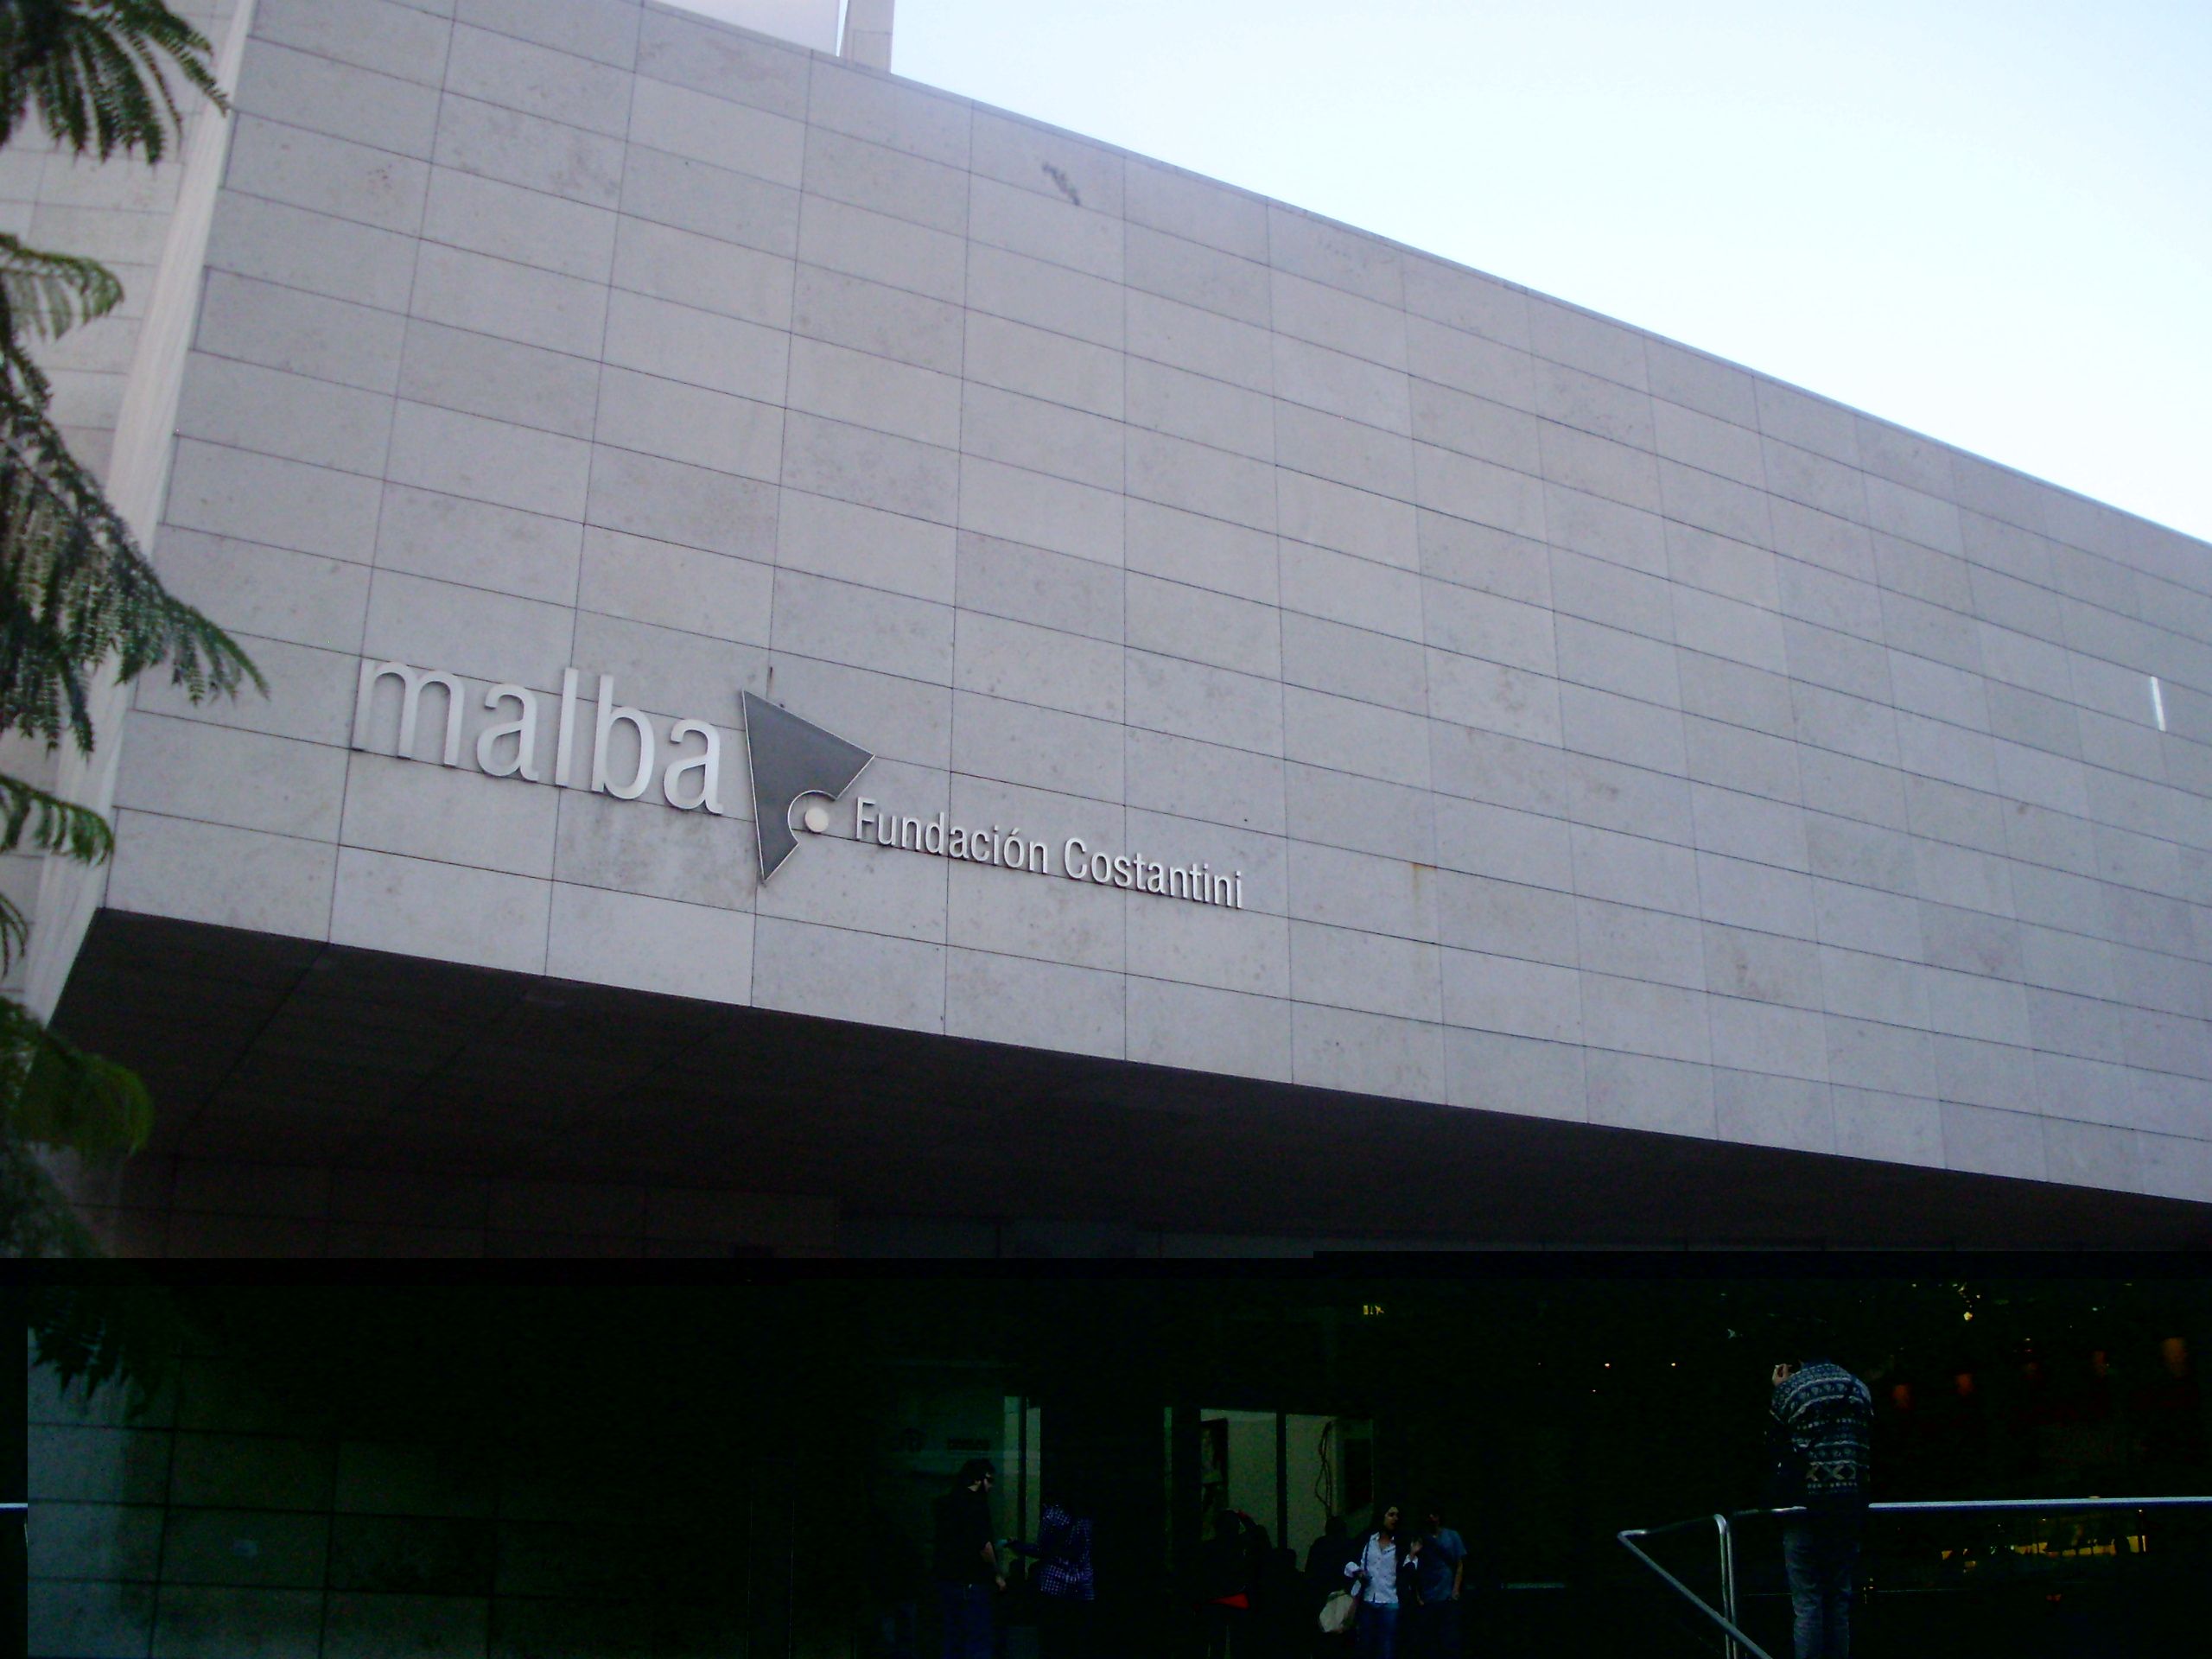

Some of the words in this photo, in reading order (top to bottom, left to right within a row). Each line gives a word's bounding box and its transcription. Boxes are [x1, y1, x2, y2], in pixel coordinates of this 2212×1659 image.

[351, 658, 723, 815] malba
[855, 797, 1049, 874] Fundación
[1064, 837, 1243, 909] Costantini
